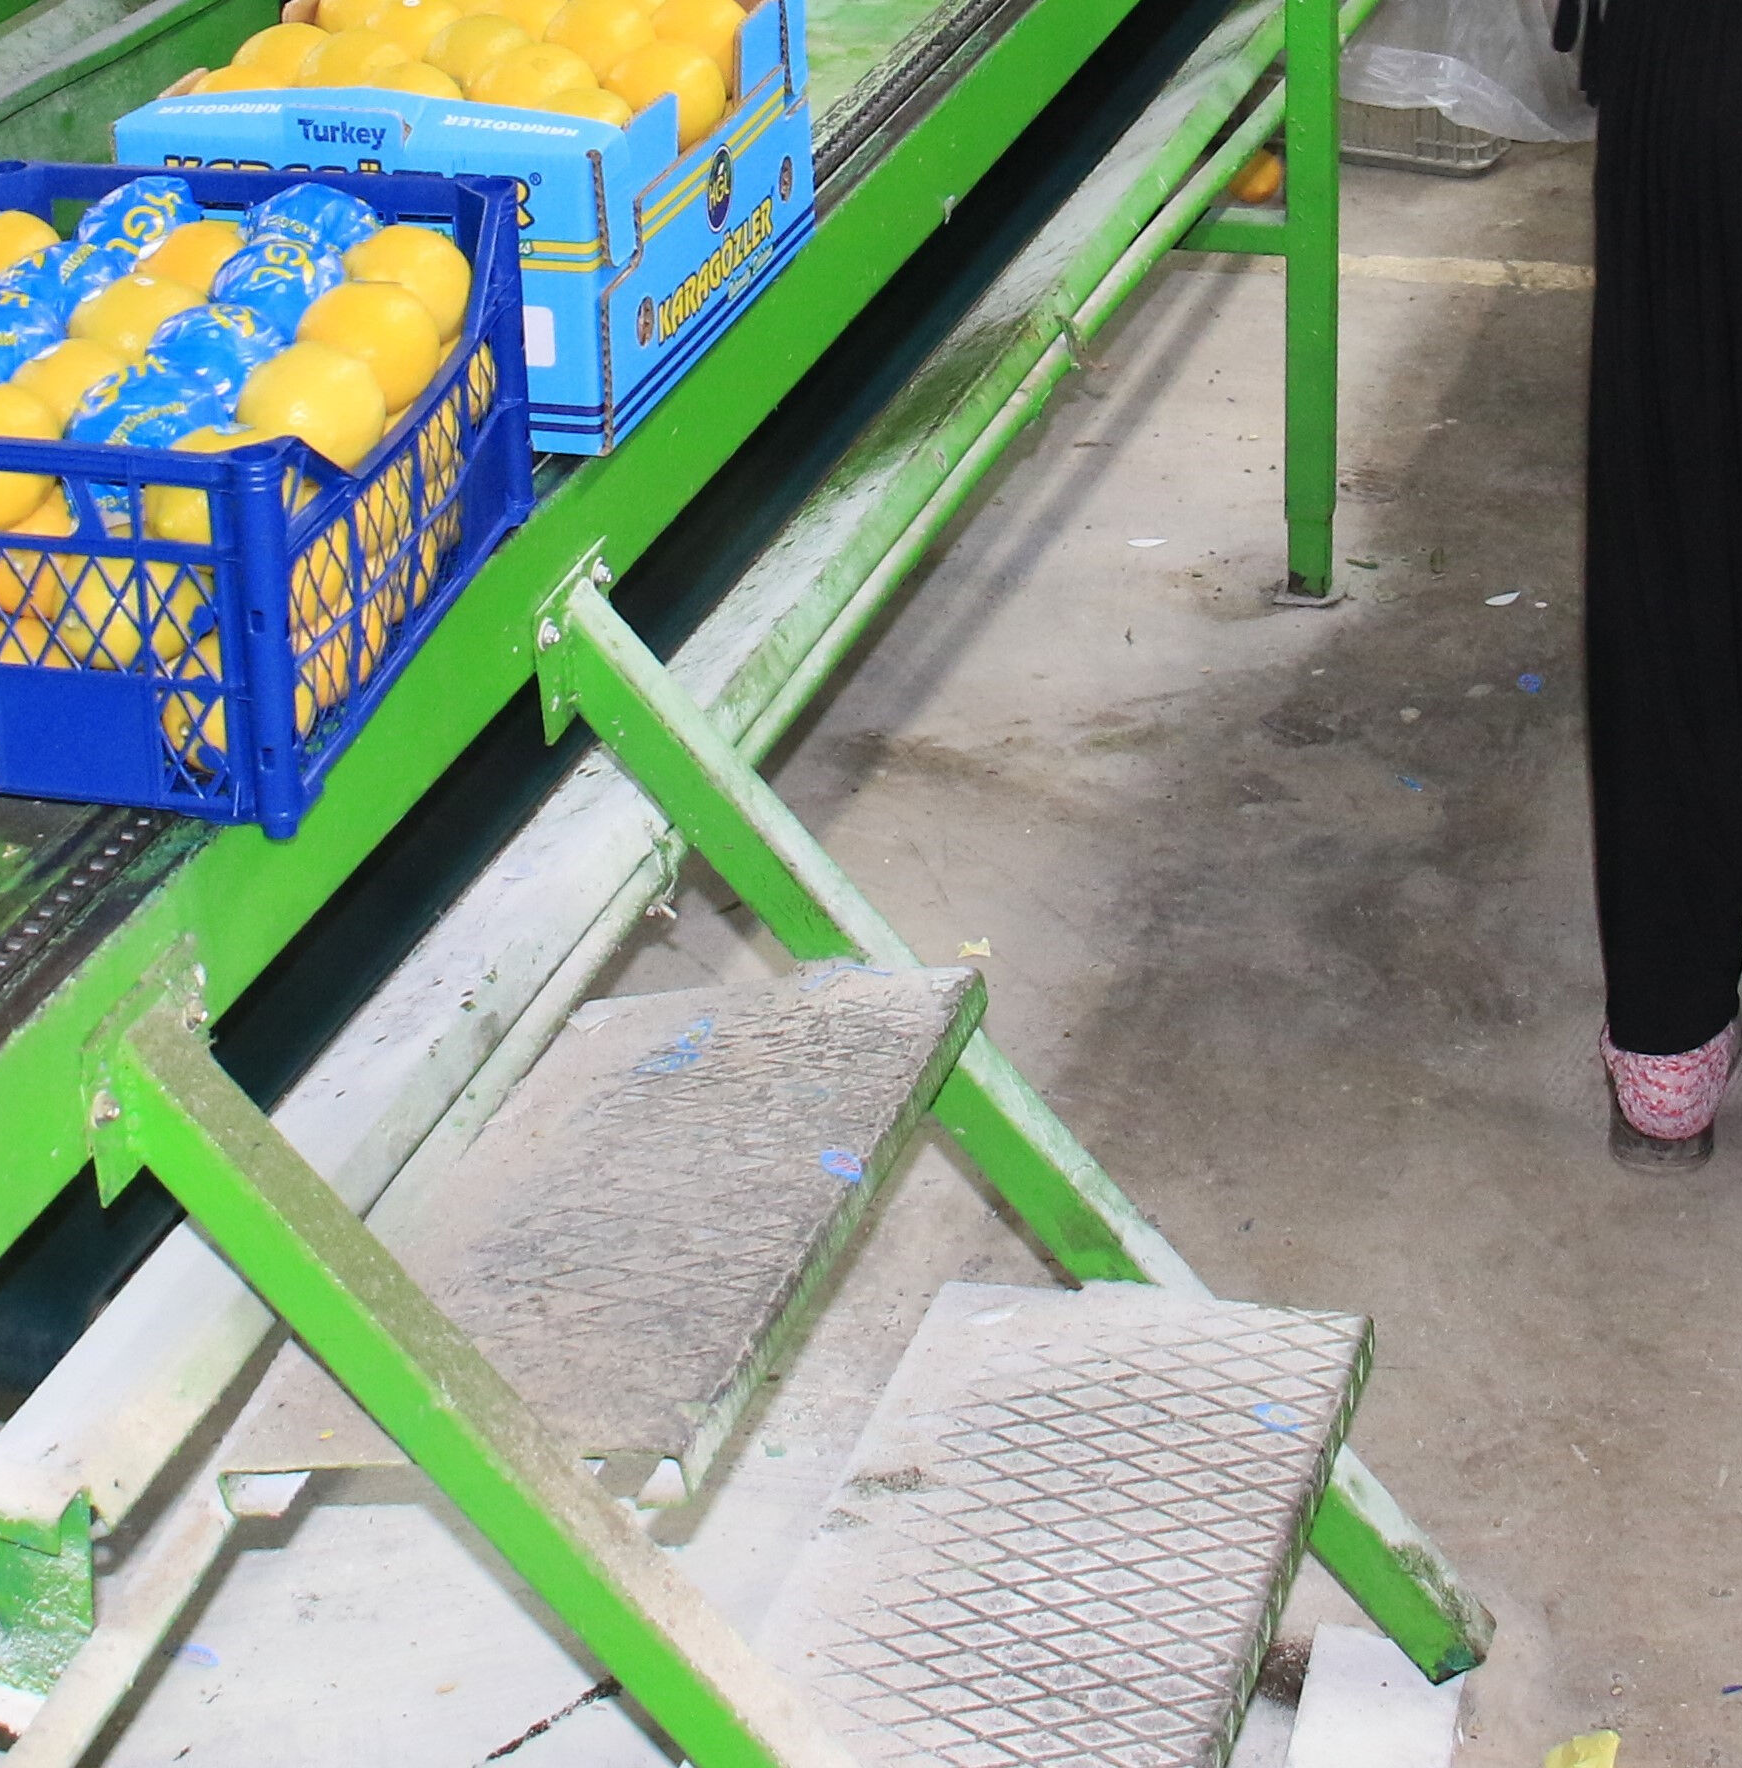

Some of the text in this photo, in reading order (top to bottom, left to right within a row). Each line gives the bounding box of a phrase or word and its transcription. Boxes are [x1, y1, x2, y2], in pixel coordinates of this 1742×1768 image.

[297, 118, 387, 151] Turkey
[441, 113, 579, 137] KARAGÖZLER
[658, 195, 773, 346] KARAGÖZLER
